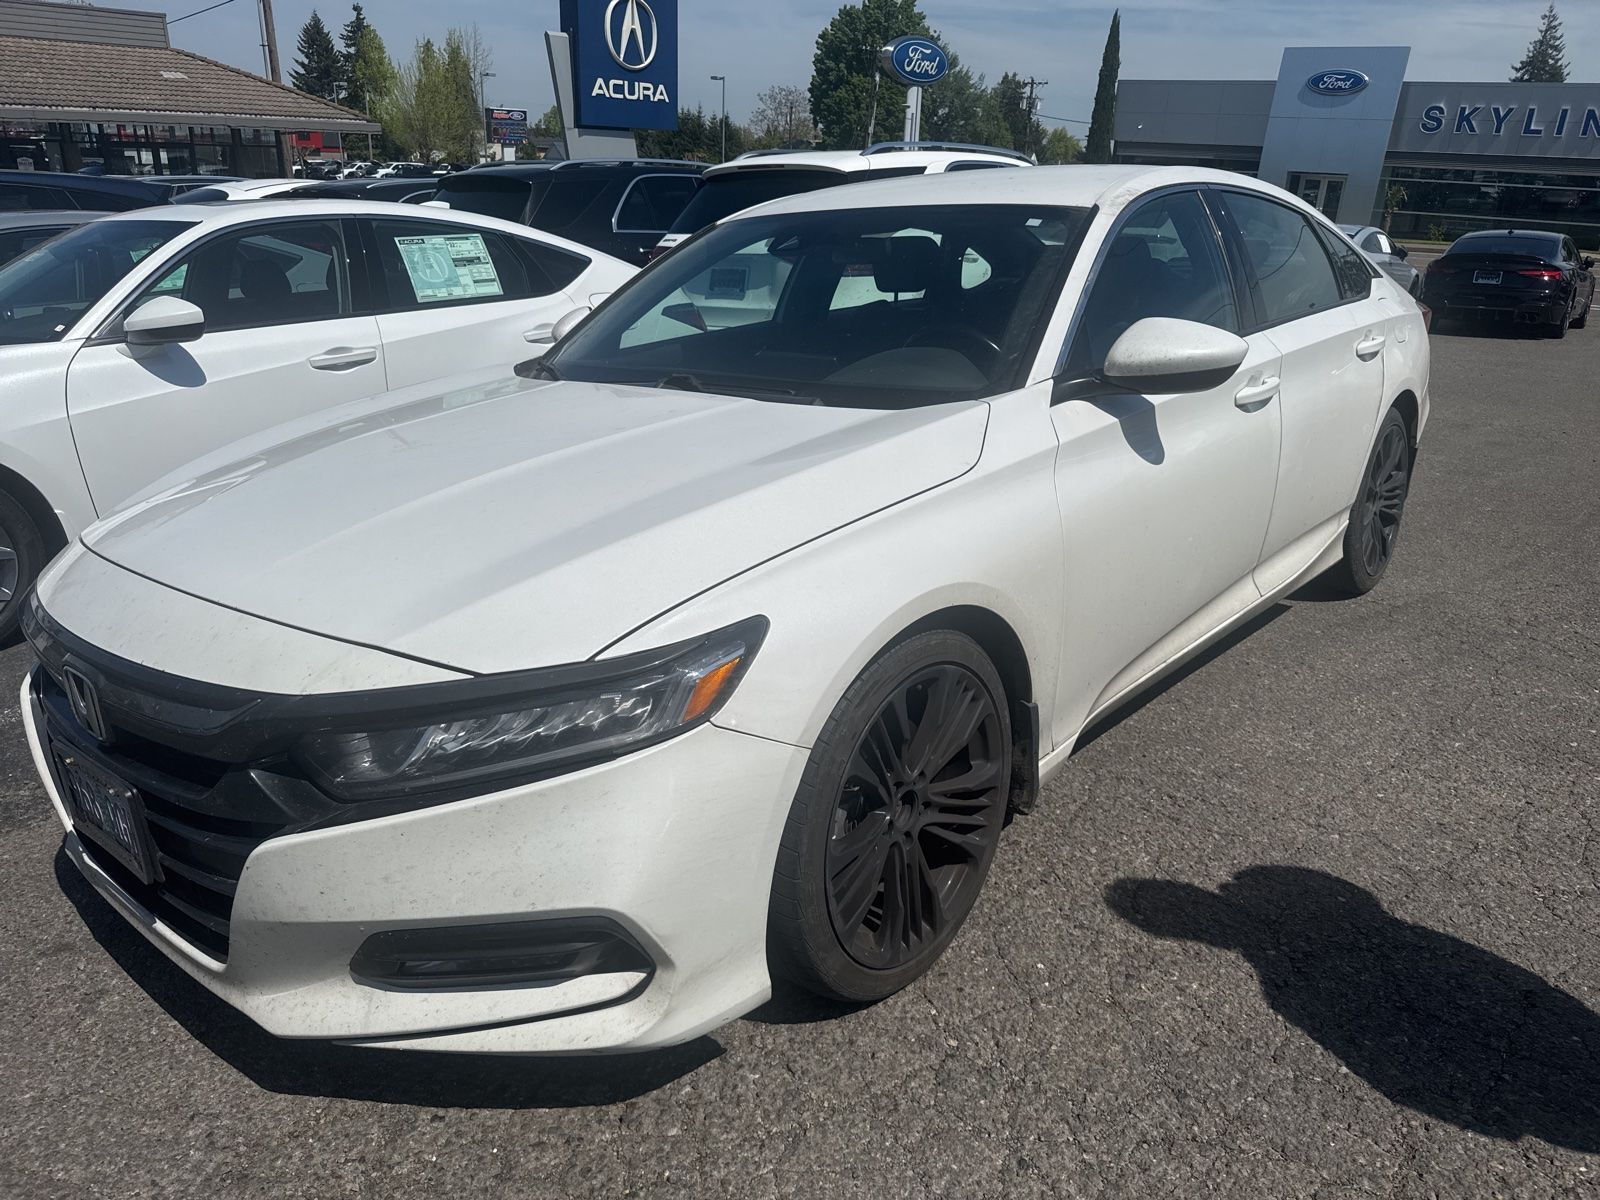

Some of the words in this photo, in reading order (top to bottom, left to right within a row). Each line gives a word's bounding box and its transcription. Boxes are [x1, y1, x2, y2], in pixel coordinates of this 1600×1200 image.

[904, 45, 940, 75] Ford
[591, 77, 670, 103] ACURA
[1319, 74, 1354, 89] Ford
[1419, 103, 1600, 137] SKYLIN
